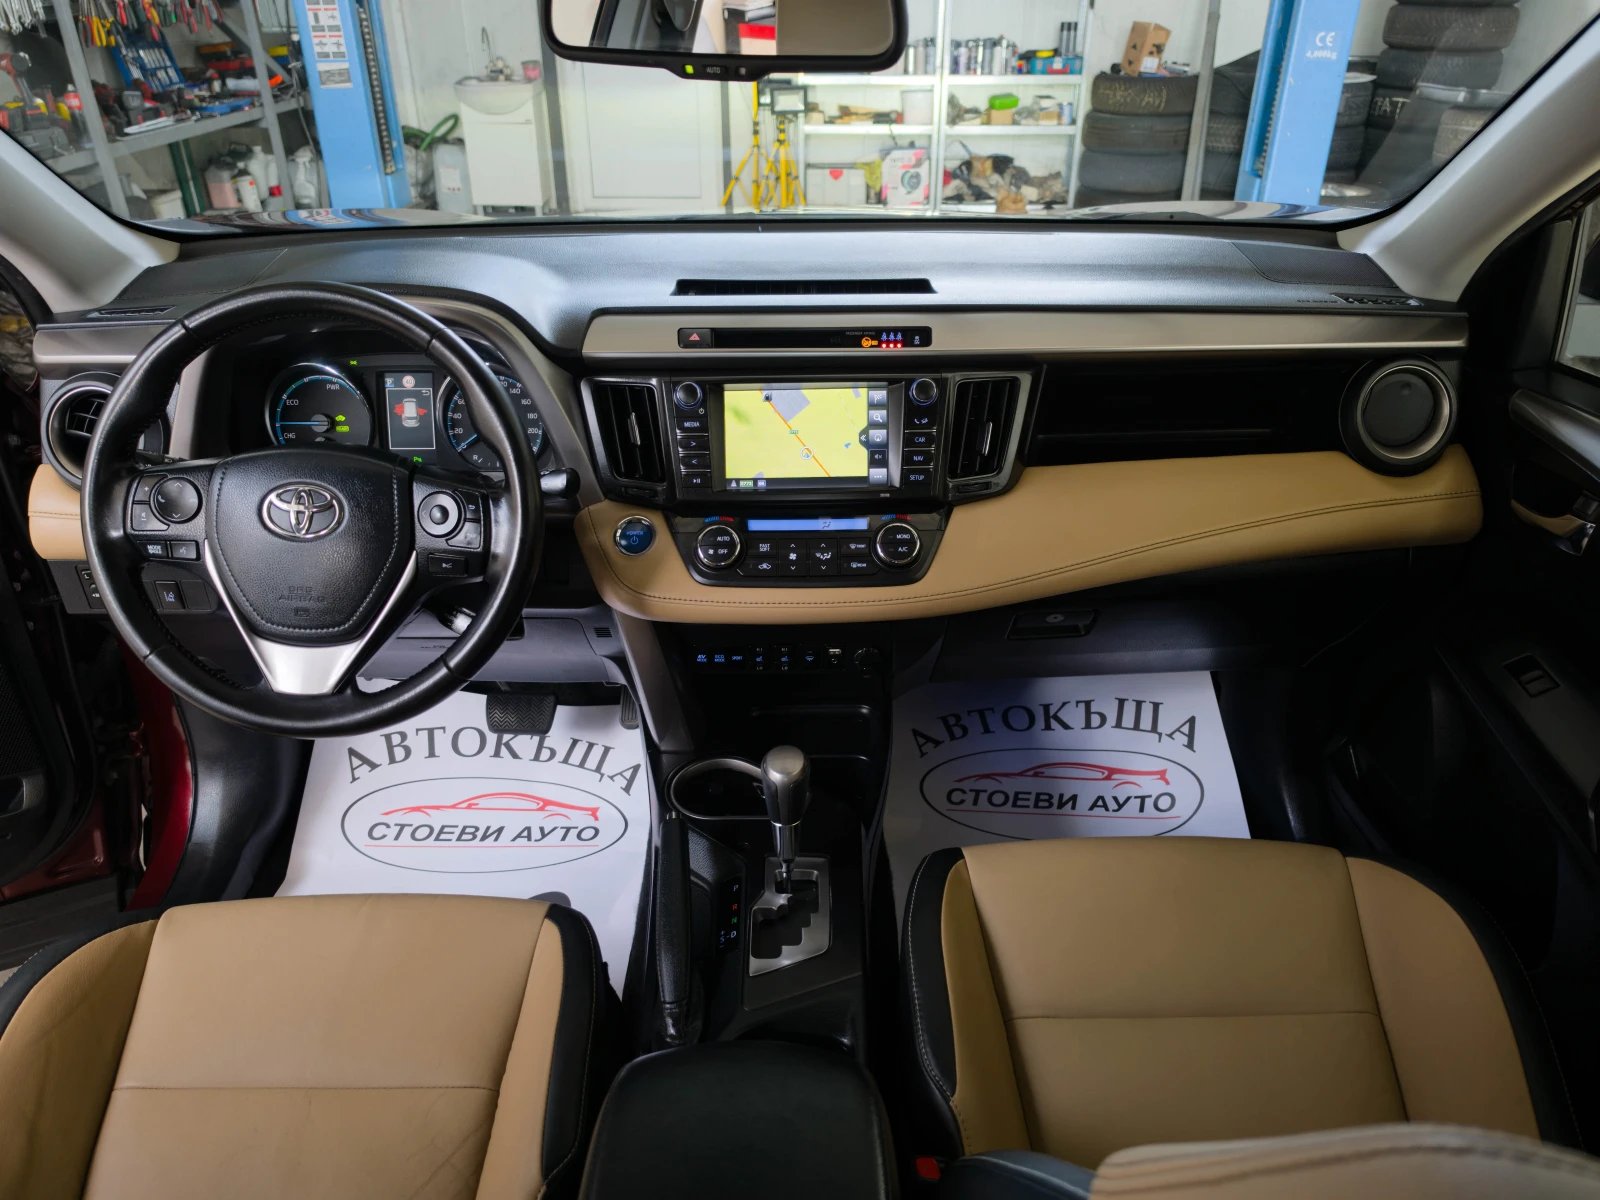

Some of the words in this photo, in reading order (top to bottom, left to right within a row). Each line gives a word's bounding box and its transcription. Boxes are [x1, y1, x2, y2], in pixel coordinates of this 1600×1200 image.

[1315, 31, 1336, 47] CE
[706, 66, 721, 74] AUTO
[326, 383, 340, 391] PWR
[910, 697, 1197, 758] АВТОКЪЩА
[347, 726, 642, 796] АВТОКЪЩА
[946, 788, 1079, 810] СТОЕВИ
[1087, 792, 1177, 813] АУТО
[367, 821, 506, 843] СТОЕВИ
[510, 825, 600, 843] АУТО
